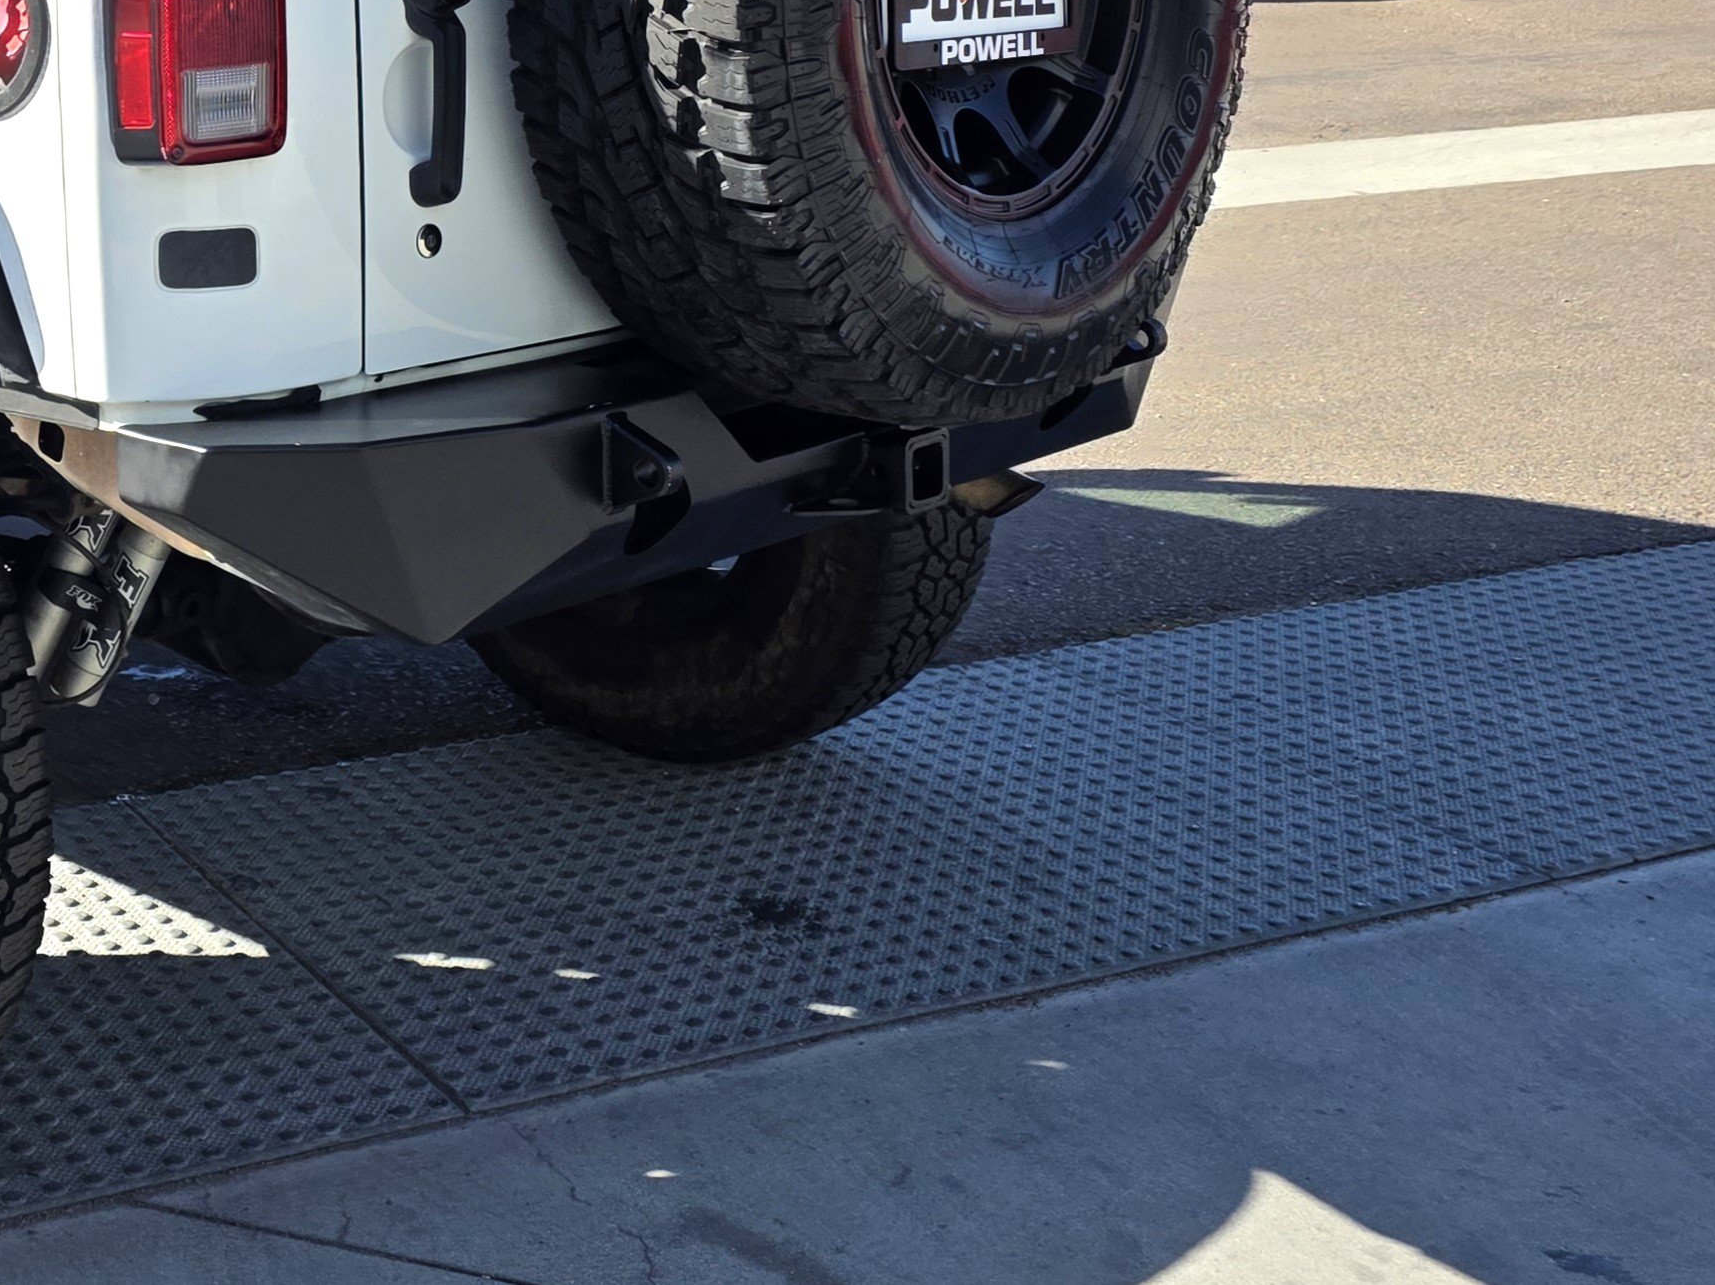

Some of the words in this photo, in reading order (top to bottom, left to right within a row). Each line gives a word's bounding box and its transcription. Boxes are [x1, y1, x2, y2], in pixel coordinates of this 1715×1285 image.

[940, 31, 1045, 66] POWELL
[1055, 26, 1217, 300] COUNTRY
[66, 584, 103, 612] FOX
